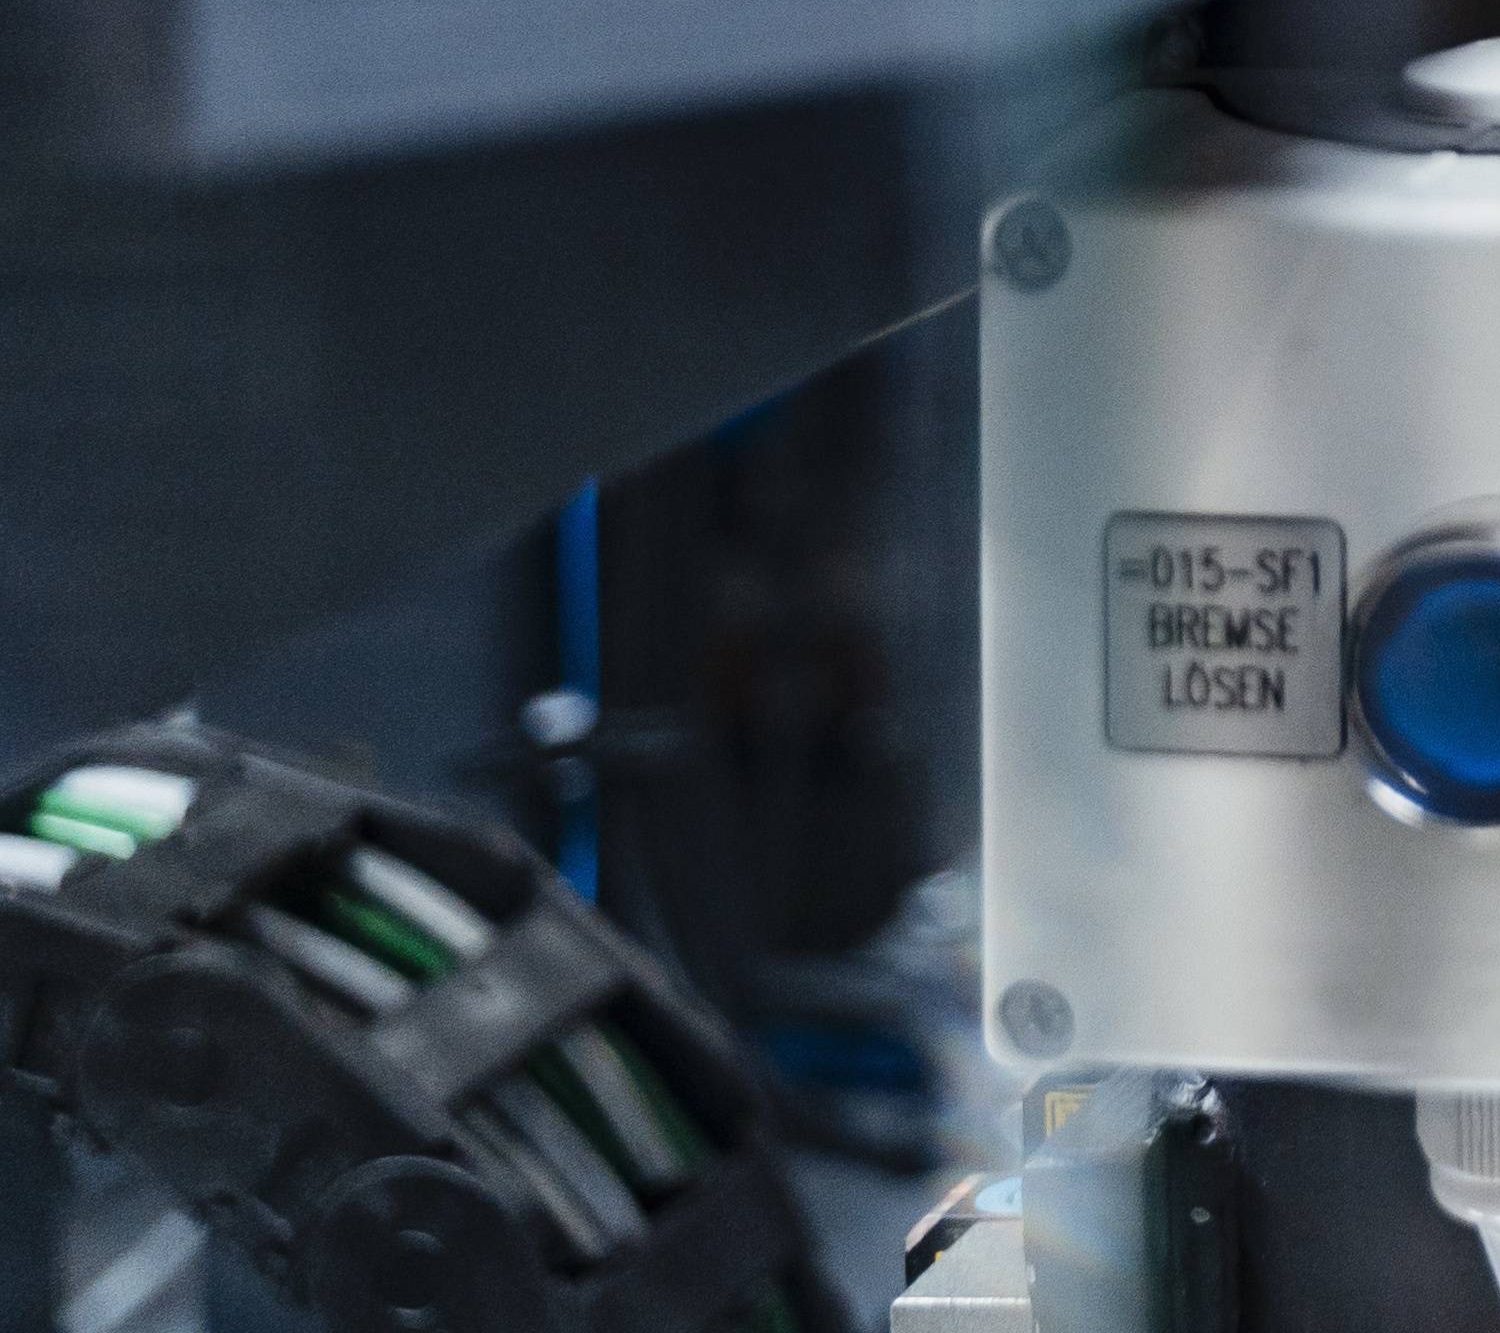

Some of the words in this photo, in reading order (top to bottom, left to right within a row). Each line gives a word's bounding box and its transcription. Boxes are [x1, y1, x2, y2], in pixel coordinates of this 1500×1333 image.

[1119, 545, 1321, 597] =015-SF1
[1150, 603, 1300, 655] BREMSE
[1162, 660, 1286, 712] LÖSEN
